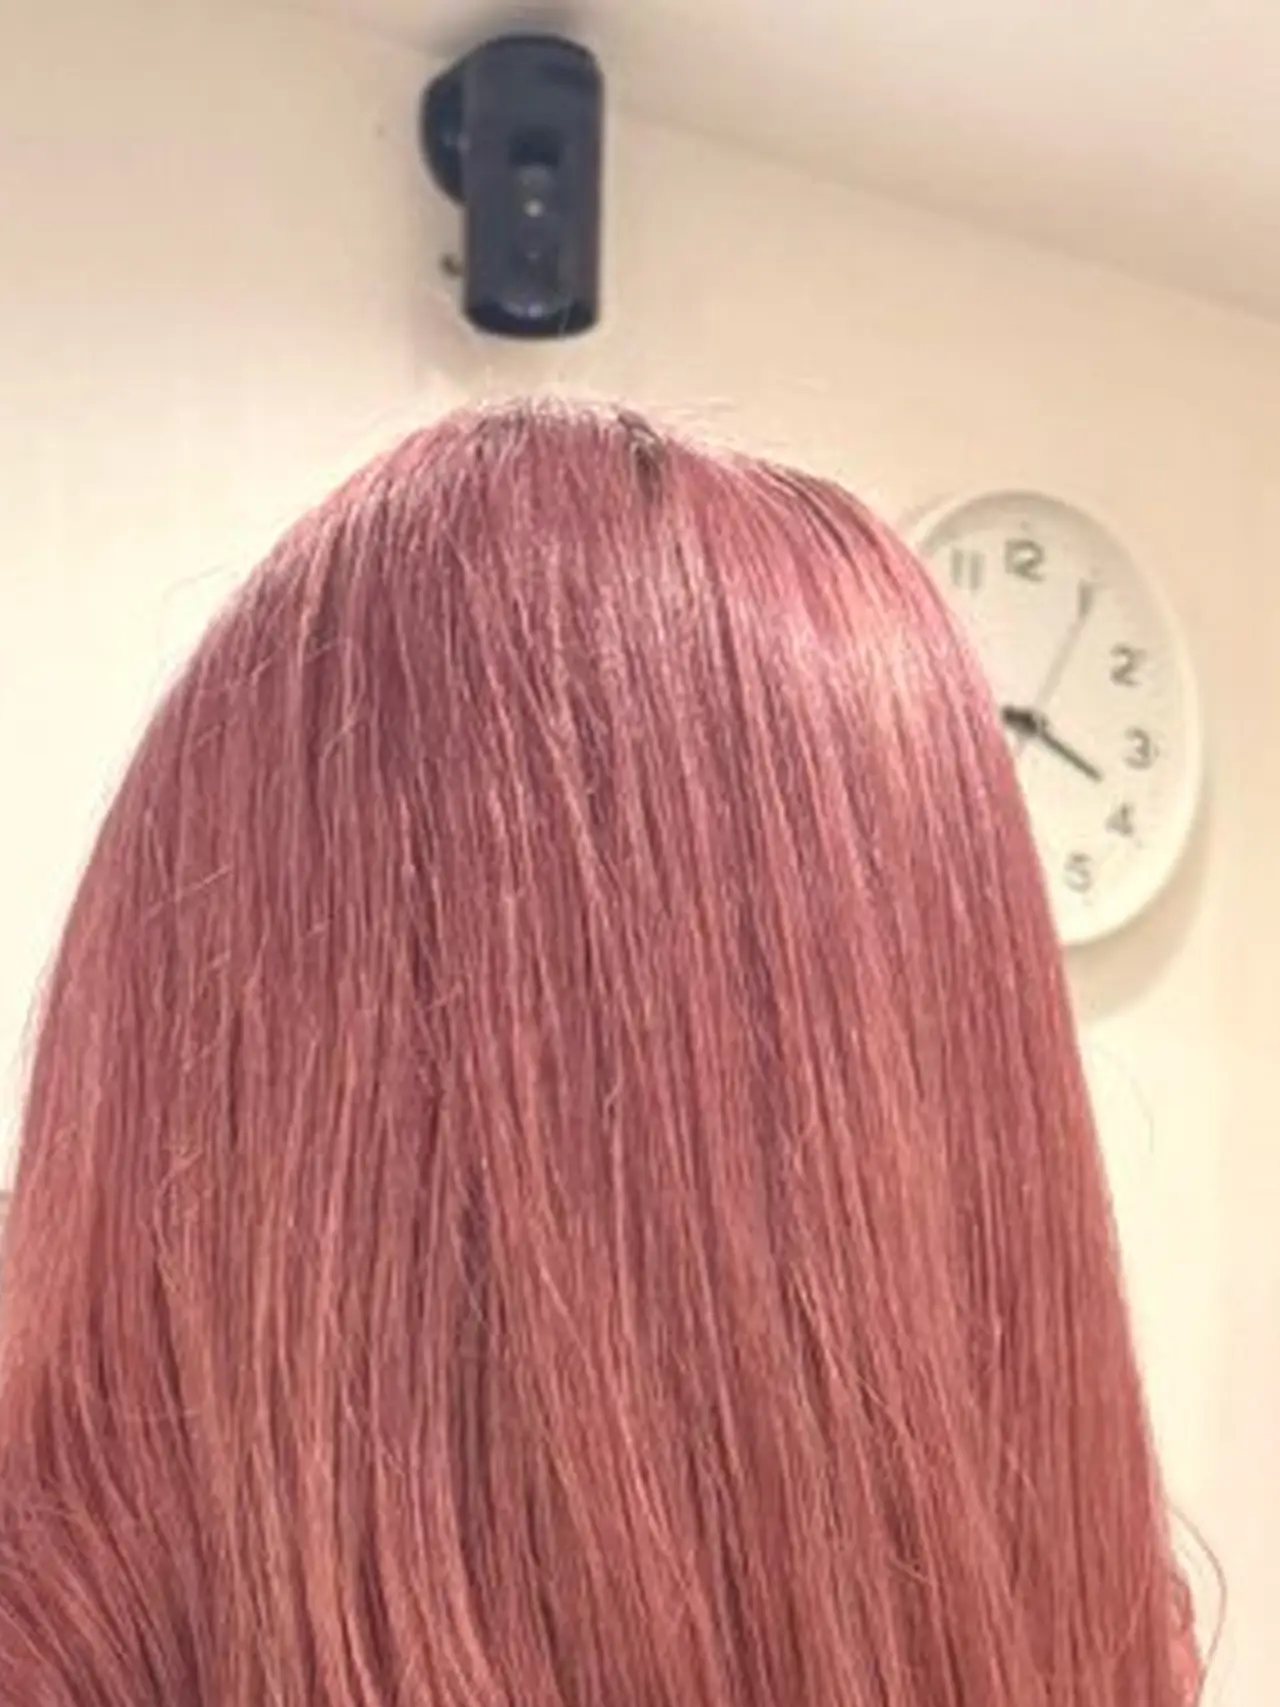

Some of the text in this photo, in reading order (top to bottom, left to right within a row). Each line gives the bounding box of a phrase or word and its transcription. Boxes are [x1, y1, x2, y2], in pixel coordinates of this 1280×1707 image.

[1003, 539, 1044, 582] 12
[1109, 645, 1144, 686] 2
[1125, 728, 1157, 770] 3
[1106, 803, 1135, 837] 4
[1064, 854, 1095, 893] 5
